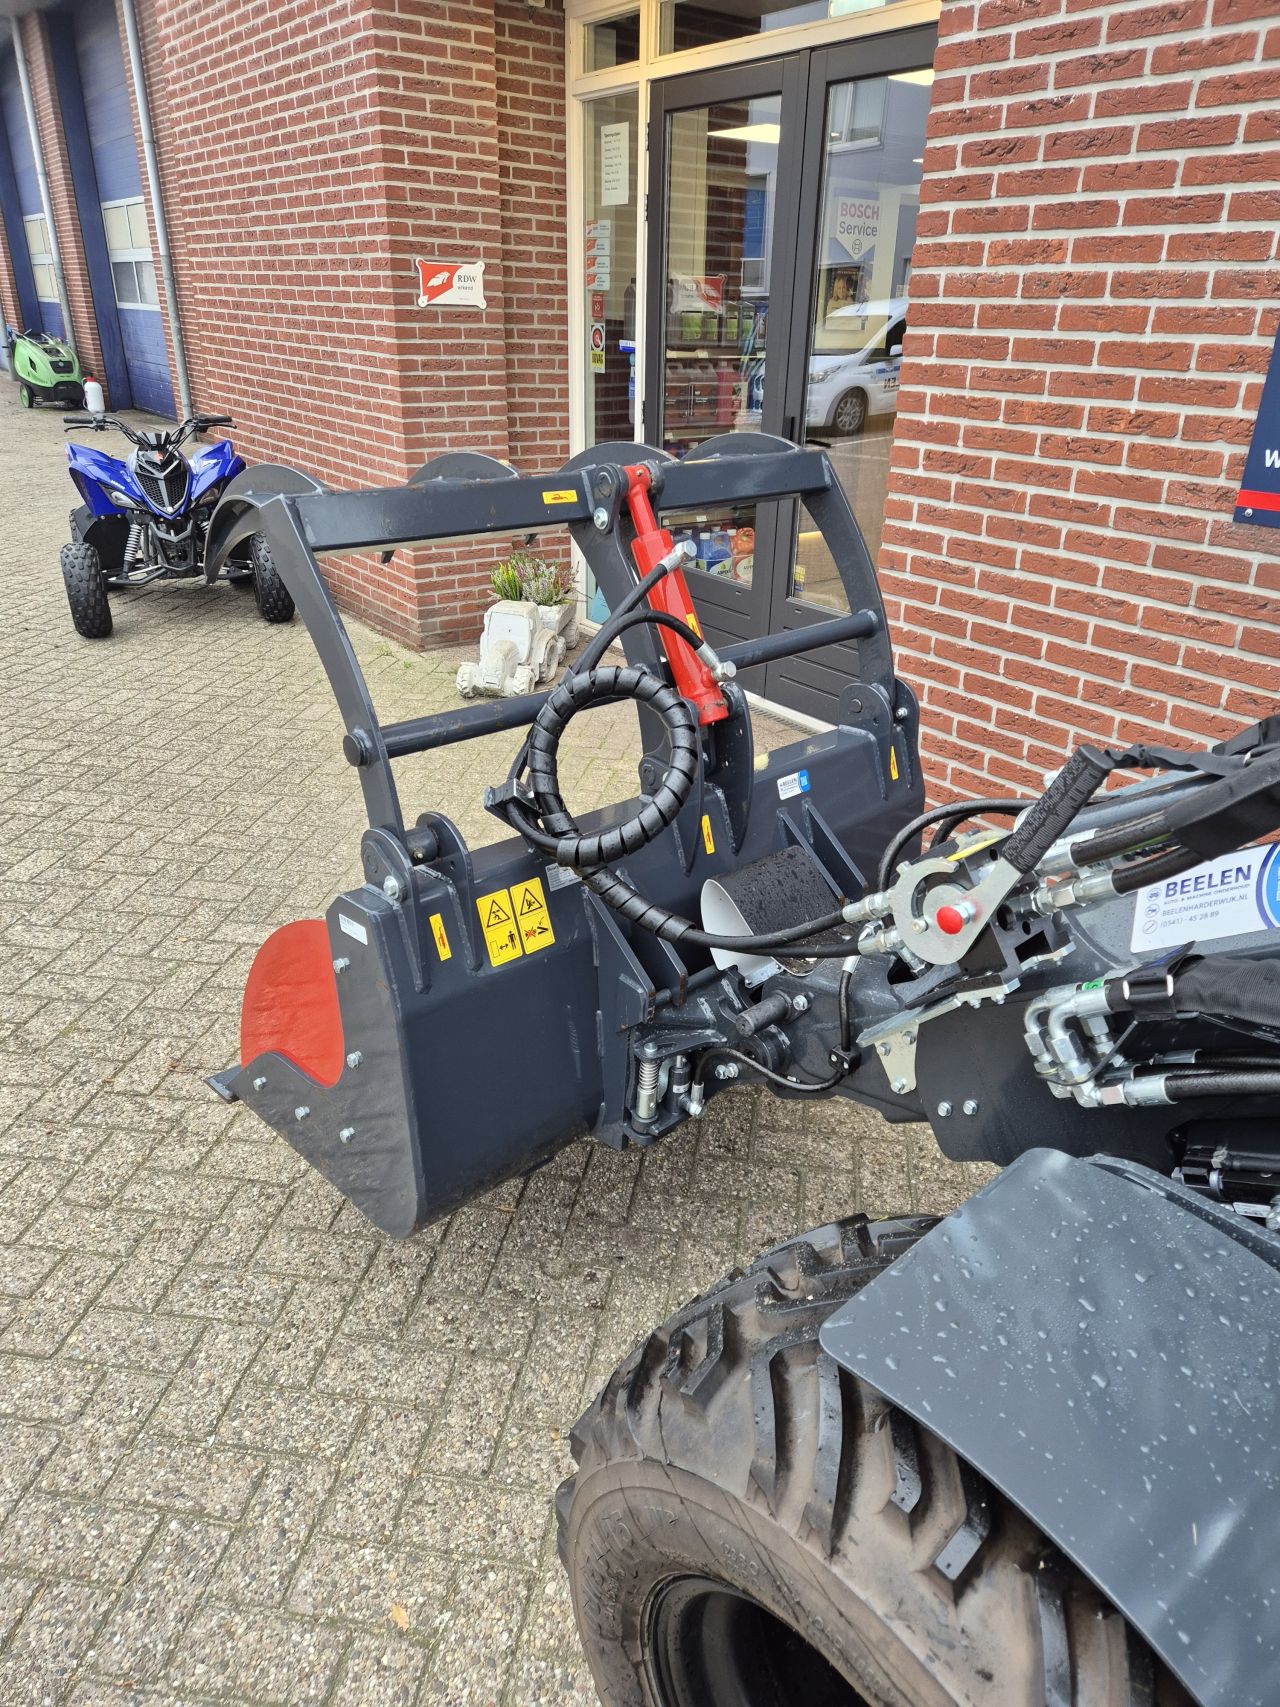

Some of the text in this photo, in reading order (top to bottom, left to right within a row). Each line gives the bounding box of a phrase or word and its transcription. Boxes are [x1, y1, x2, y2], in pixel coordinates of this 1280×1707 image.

[840, 202, 880, 220] BOSCH
[839, 221, 878, 237] Service
[457, 274, 477, 283] RDW
[1165, 864, 1252, 898] BEELEN
[1162, 893, 1248, 916] BEELENHARDERWIJK.NL
